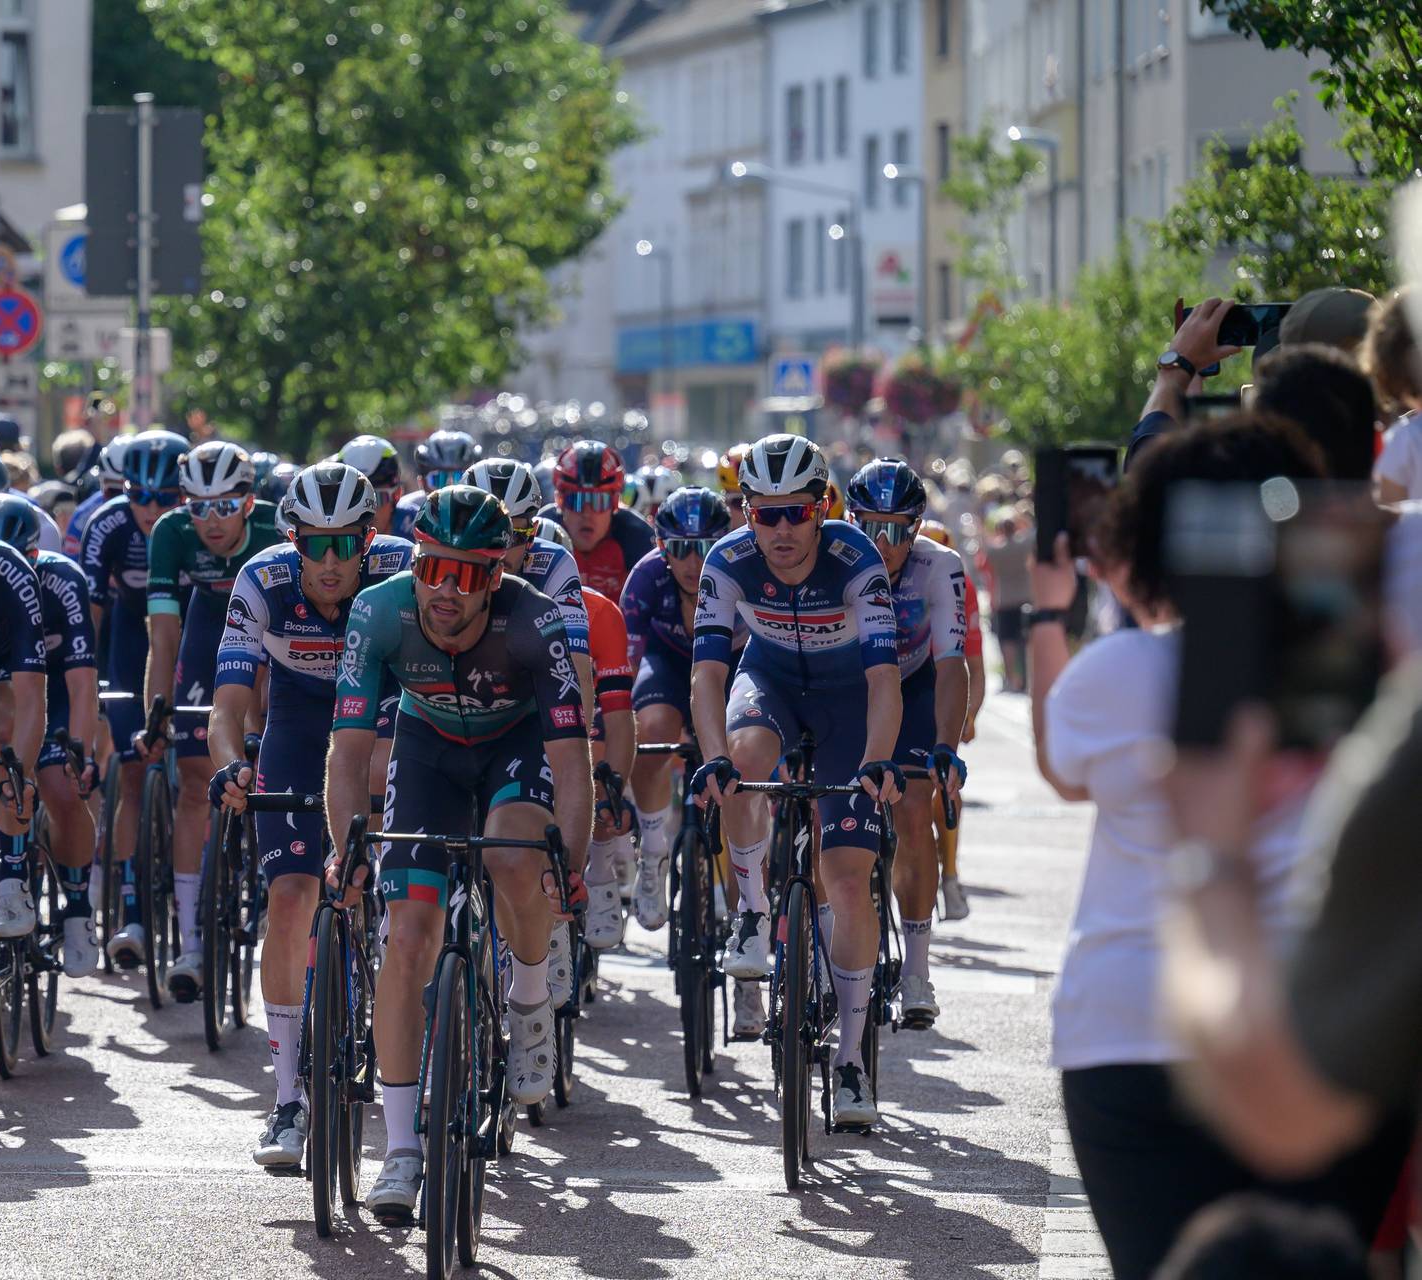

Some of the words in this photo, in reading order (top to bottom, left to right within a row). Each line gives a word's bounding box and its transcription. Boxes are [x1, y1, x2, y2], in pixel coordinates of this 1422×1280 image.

[85, 510, 127, 568] youfone
[41, 570, 83, 625] youfone
[352, 599, 372, 617] RA
[533, 608, 561, 629] BOR
[864, 613, 896, 623] NAPOL
[284, 621, 322, 633] Ekopak
[756, 618, 846, 634] SOUDAL
[873, 638, 896, 648] JANO
[24, 657, 47, 665] SCO
[405, 662, 419, 672] LE
[420, 663, 442, 672] COL
[344, 699, 363, 708] ÖTZ
[554, 709, 574, 718] ÖTZ
[529, 787, 550, 803] LE
[382, 879, 399, 894] OL
